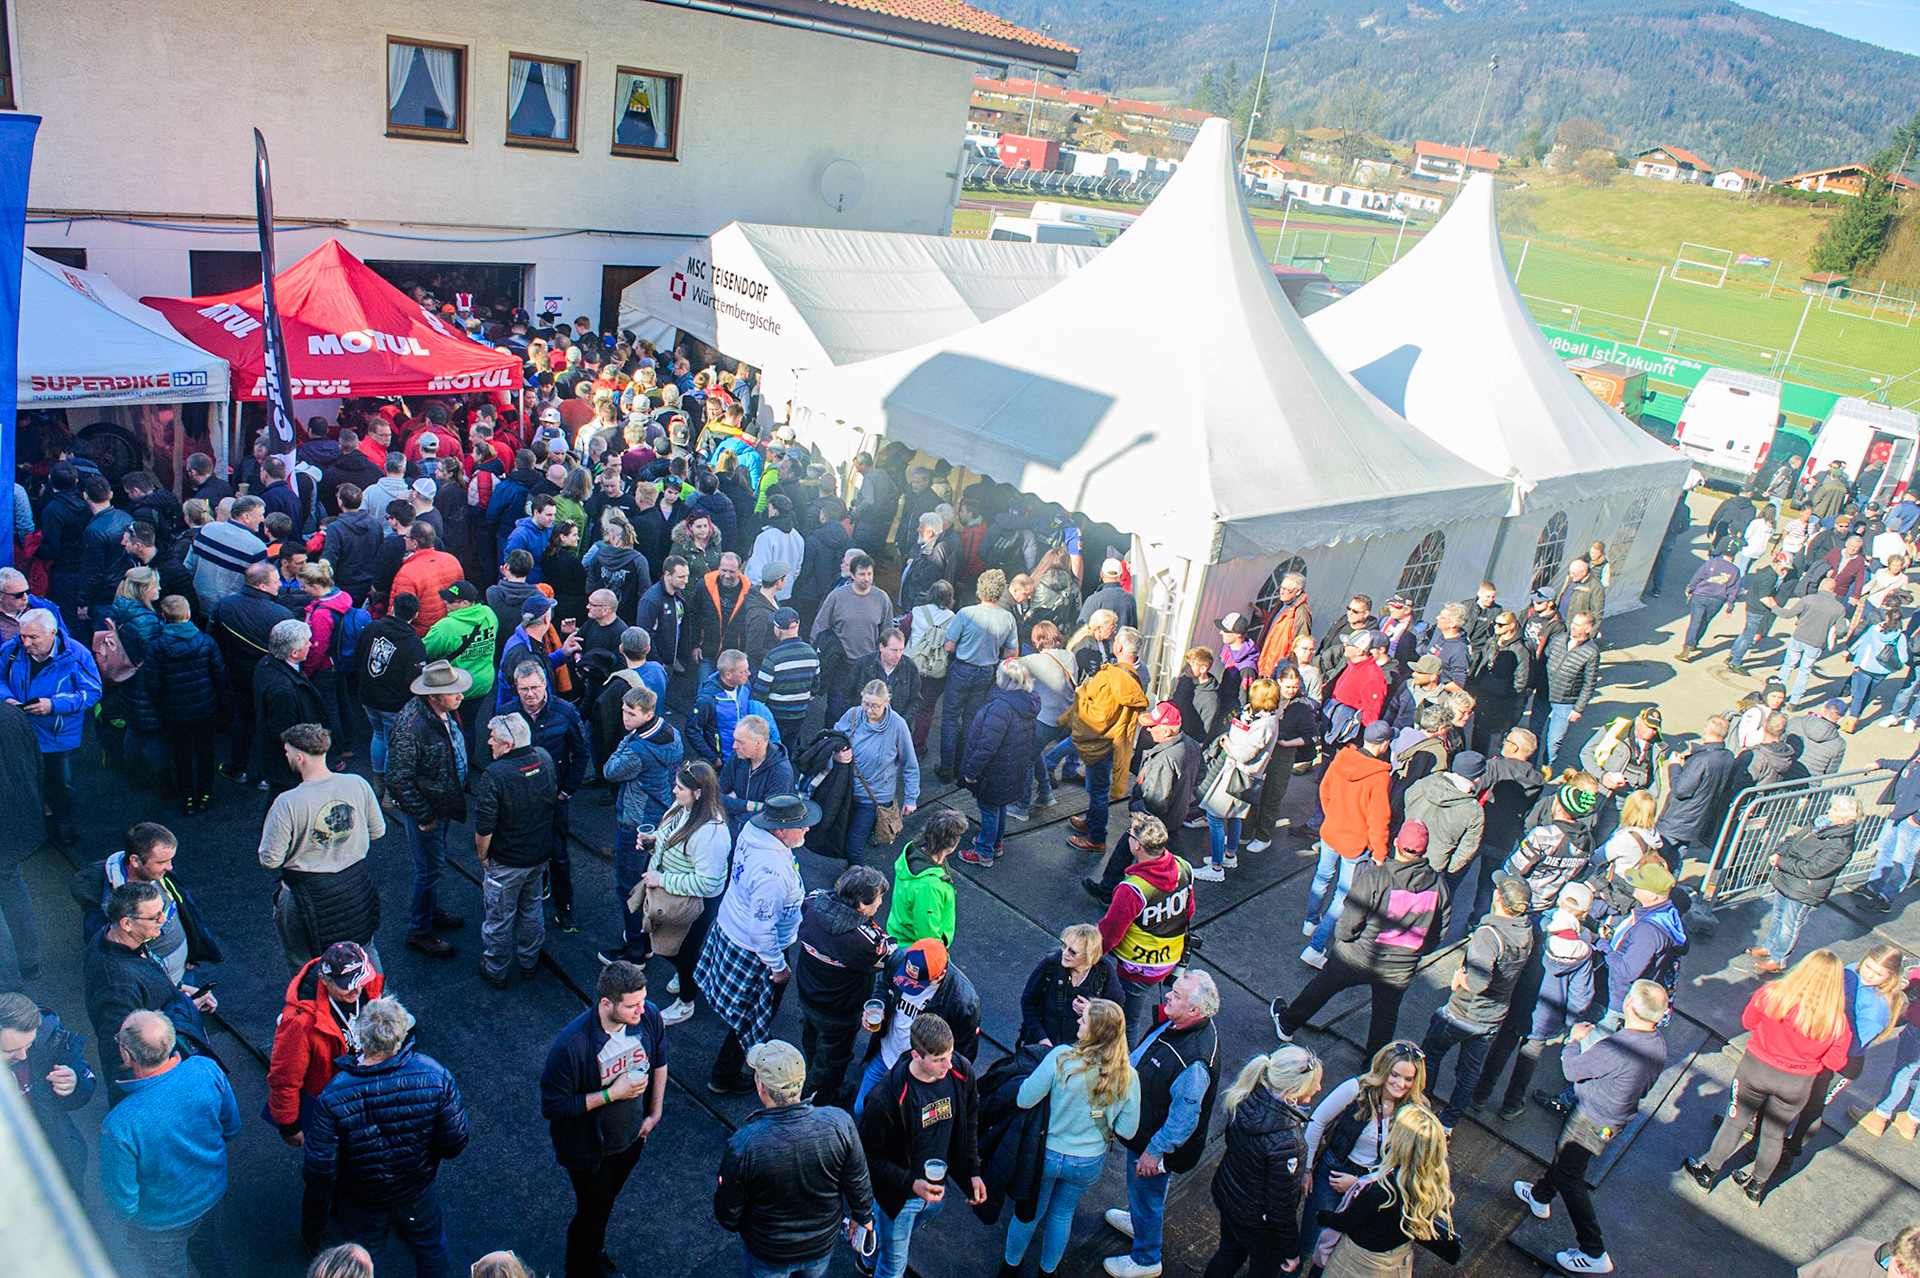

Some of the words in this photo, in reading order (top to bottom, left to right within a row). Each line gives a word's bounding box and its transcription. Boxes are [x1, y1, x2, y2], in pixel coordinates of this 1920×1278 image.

[686, 256, 707, 280] MSC
[711, 265, 769, 303] TEISENDORF
[692, 285, 781, 336] Württembergische
[308, 329, 430, 356] MOTUL
[1547, 337, 1588, 356] ußball
[1591, 345, 1612, 363] ist
[1614, 352, 1677, 378] Zukunft
[30, 373, 171, 392] SUPERBIKE
[428, 369, 513, 391] MOTUL
[32, 393, 101, 402] INTERNATIONAL
[105, 389, 142, 399] GERMAN
[145, 388, 208, 397] CHAMPIONSHIP
[1542, 856, 1561, 867] DIE
[601, 1056, 627, 1080] udi
[633, 1048, 649, 1064] S
